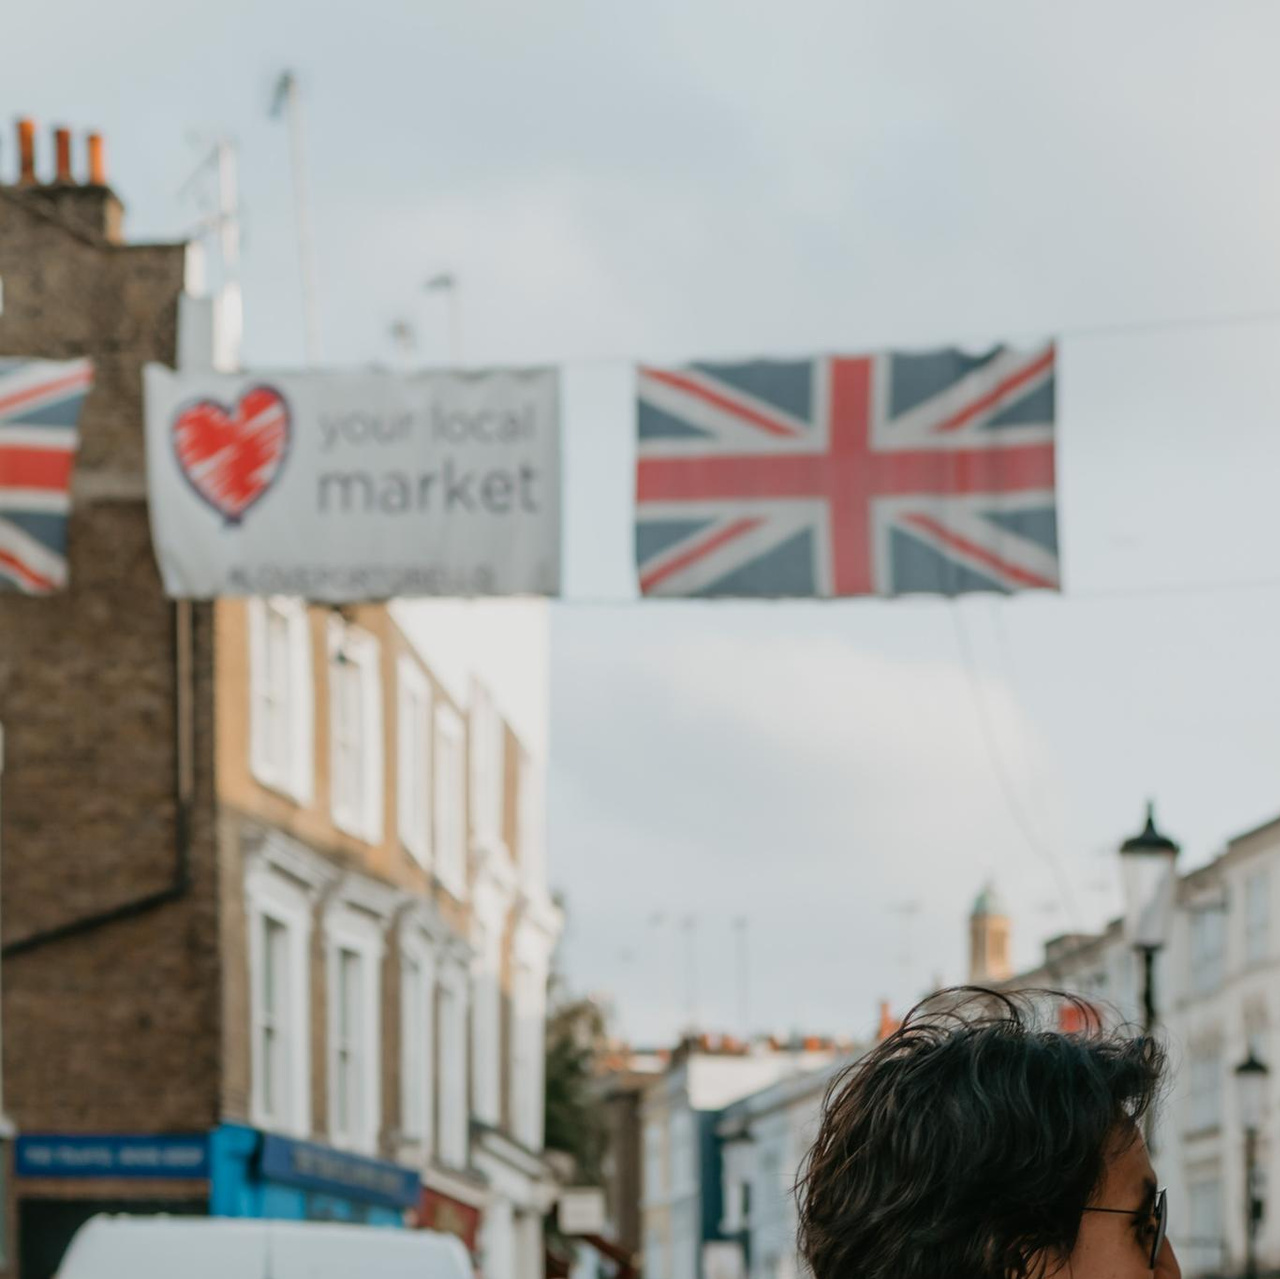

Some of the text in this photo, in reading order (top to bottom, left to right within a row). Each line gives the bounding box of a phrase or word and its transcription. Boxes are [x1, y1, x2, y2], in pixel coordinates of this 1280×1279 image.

[317, 396, 537, 453] your local
[317, 454, 540, 515] market
